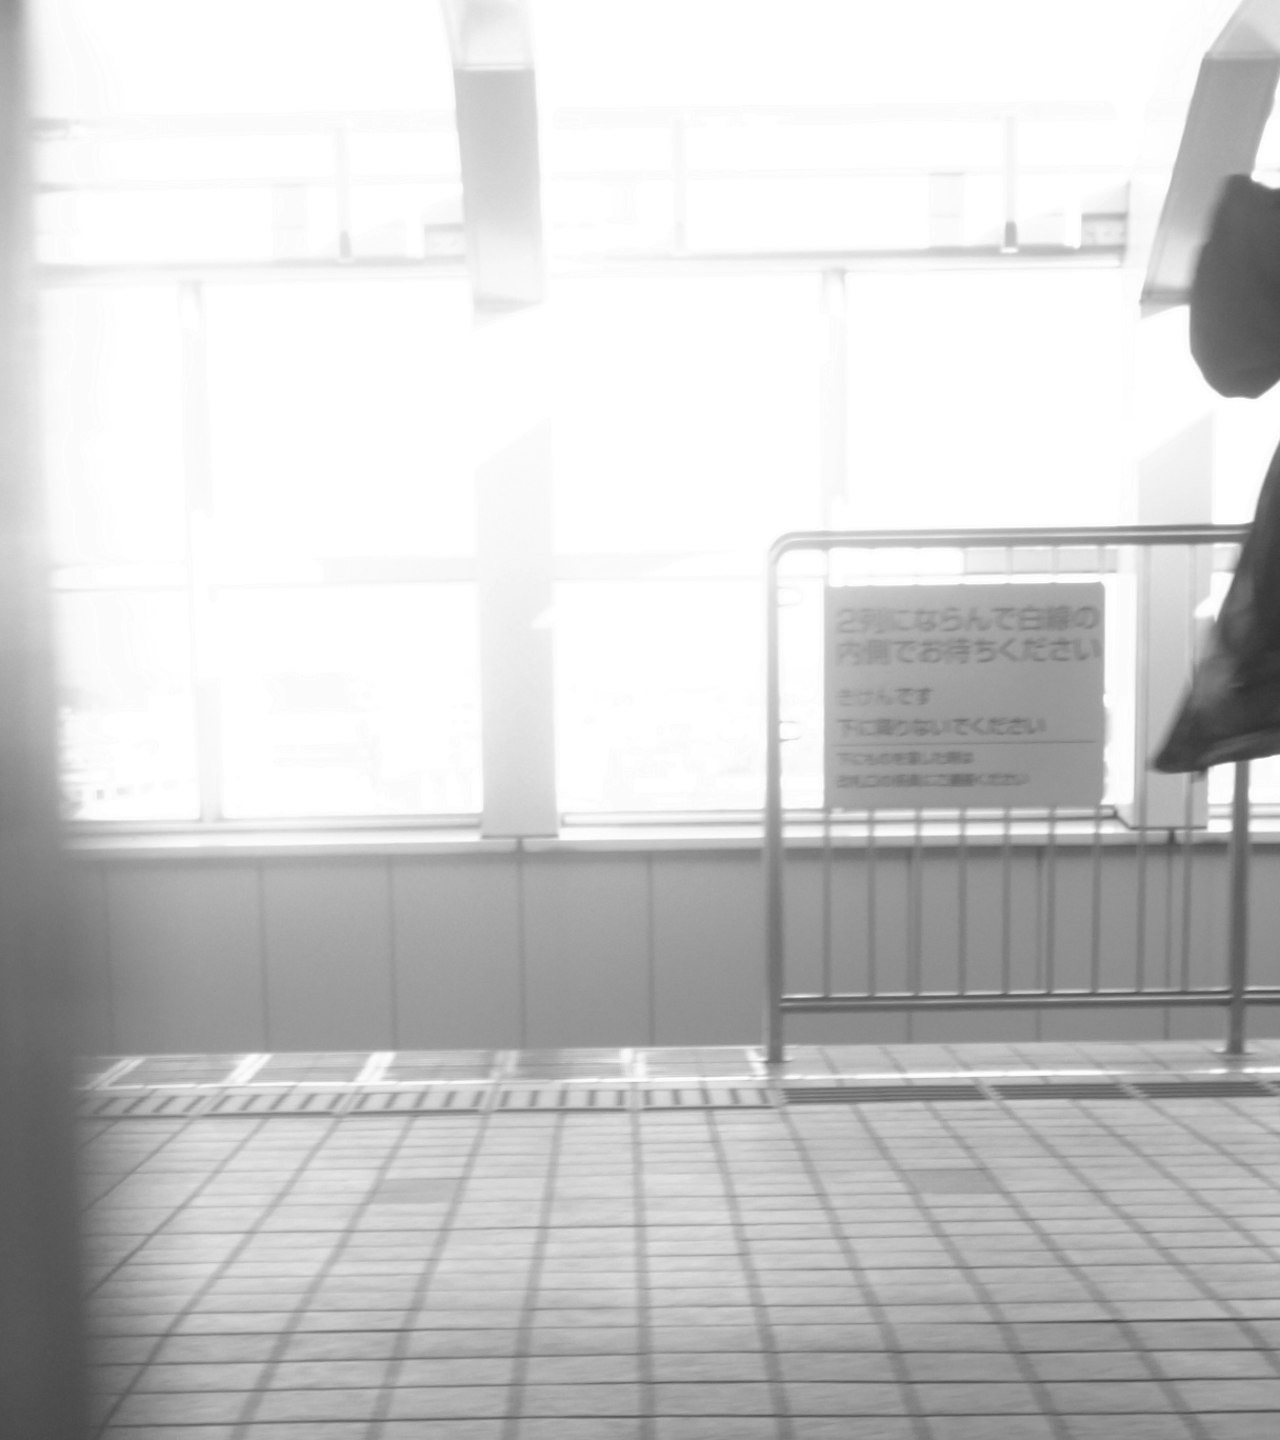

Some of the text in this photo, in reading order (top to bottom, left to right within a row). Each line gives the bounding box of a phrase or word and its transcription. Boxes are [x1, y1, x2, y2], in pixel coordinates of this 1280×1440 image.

[834, 605, 1101, 634] 2列にならんで白線の
[834, 638, 1103, 666] 内側でお待ちください
